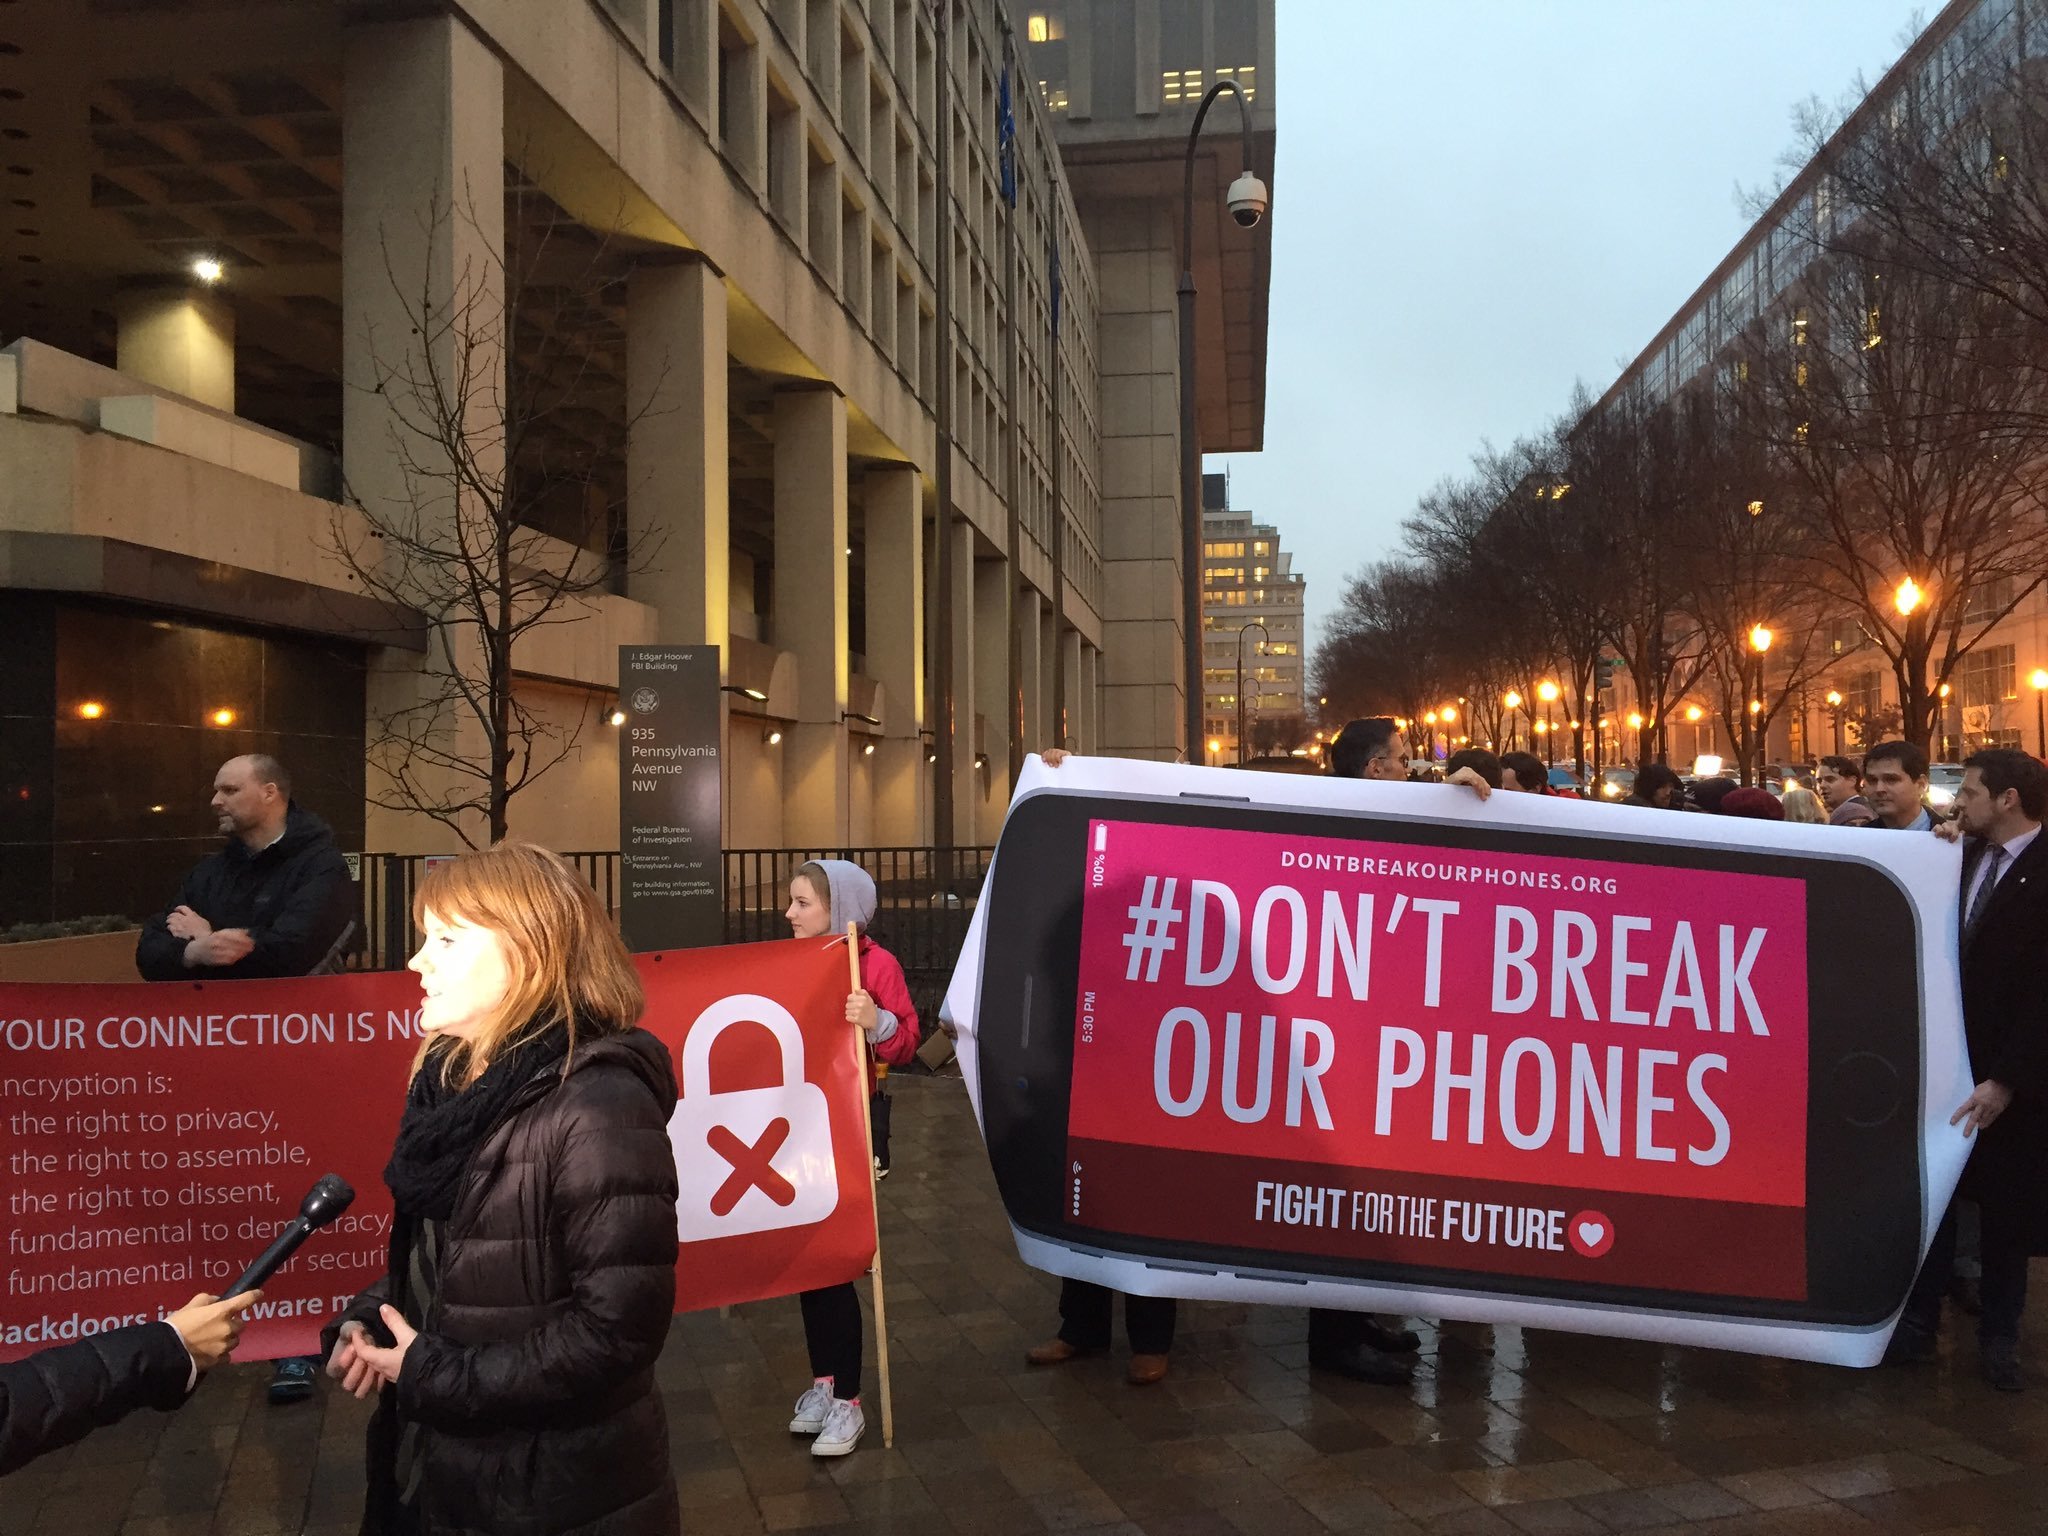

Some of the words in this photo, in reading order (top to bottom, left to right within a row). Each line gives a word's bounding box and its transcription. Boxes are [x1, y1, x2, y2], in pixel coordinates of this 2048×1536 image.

[639, 653, 662, 662] Edgar
[664, 653, 693, 661] Hoover
[645, 663, 678, 672] Building
[631, 728, 656, 740] 935
[632, 745, 717, 760] Pennsylvania
[632, 763, 683, 775] Avenue
[632, 780, 657, 792] NW
[632, 826, 660, 834] Federal
[662, 825, 690, 834] Bureau
[632, 836, 641, 844] of
[643, 836, 692, 845] Investigation
[645, 881, 671, 889] building
[673, 880, 710, 888] information
[1092, 854, 1105, 888] 100%
[1282, 851, 1618, 895] DONTBREAKOURPHONES.ORG
[633, 890, 641, 898] go
[1122, 875, 1460, 1008] #DON'T
[1491, 904, 1771, 1038] BREAK
[1084, 991, 1096, 1012] PM
[0, 1017, 85, 1051] OUR
[96, 1013, 334, 1049] CONNECTION
[348, 1012, 375, 1043] IS
[1082, 1015, 1094, 1043] 5:30
[0, 1072, 137, 1103] ncryption
[147, 1071, 173, 1094] is:
[1153, 1006, 1335, 1131] OUR
[1374, 1025, 1731, 1168] PHONES
[10, 1111, 56, 1136] the
[66, 1108, 130, 1139] right
[138, 1112, 167, 1133] to
[176, 1107, 280, 1137] privacy,
[10, 1149, 58, 1175] the
[67, 1147, 133, 1178] right
[139, 1151, 168, 1170] to
[176, 1141, 311, 1168] assemble,
[10, 1188, 58, 1215] the
[68, 1184, 133, 1216] right
[141, 1187, 170, 1208] to
[178, 1181, 281, 1206] dissent,
[1255, 1181, 1346, 1229] FIGHT
[1352, 1191, 1394, 1235] FOR
[1397, 1195, 1437, 1239] THE
[1442, 1200, 1566, 1251] FUTURE
[8, 1218, 192, 1255] fundamental
[200, 1222, 229, 1242] to
[8, 1255, 193, 1296] fundamental
[202, 1258, 230, 1279] to
[307, 1245, 390, 1272] securi
[0, 1312, 148, 1345] ackdoors
